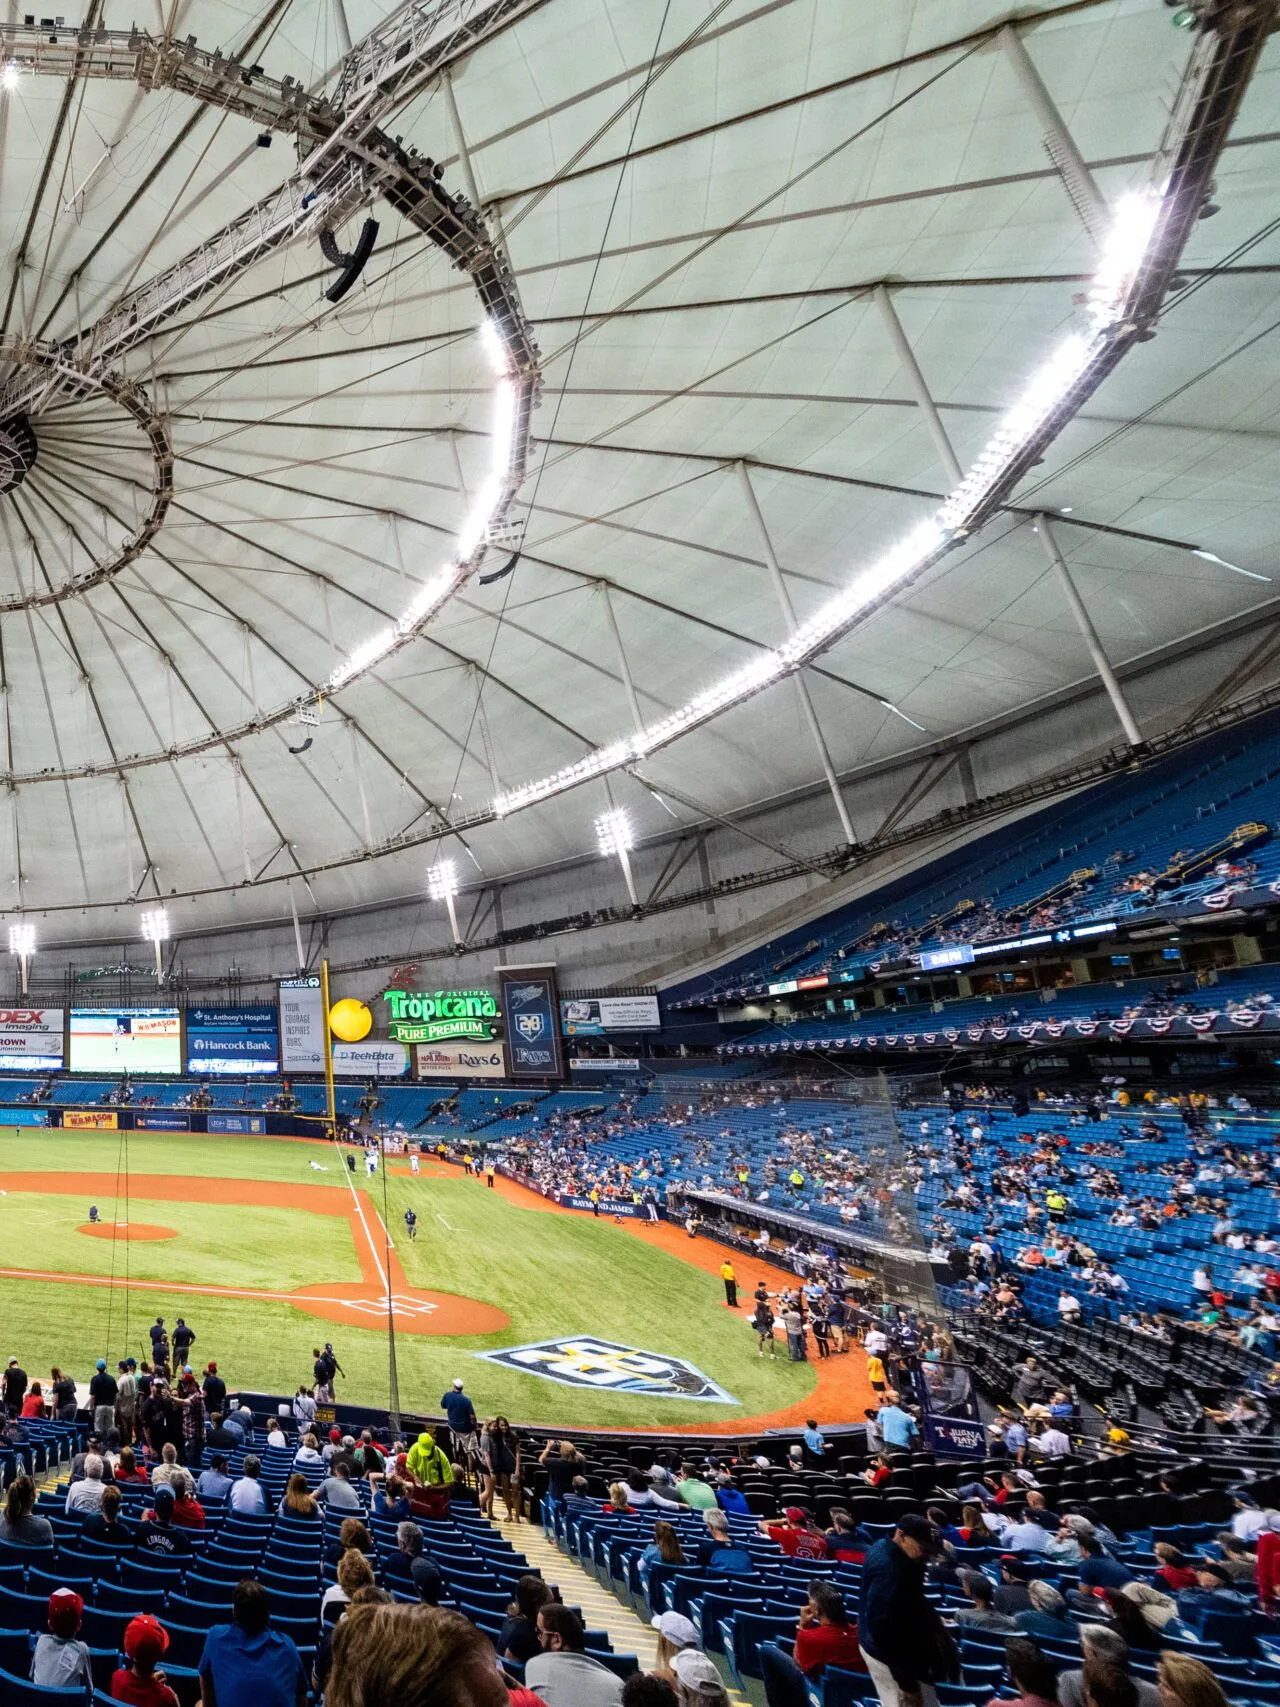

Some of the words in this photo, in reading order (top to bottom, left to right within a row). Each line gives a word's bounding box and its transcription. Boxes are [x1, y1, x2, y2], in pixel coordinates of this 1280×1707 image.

[285, 1003, 300, 1012] YOUR
[384, 990, 497, 1021] Tropicana
[244, 1013, 271, 1021] Hospital
[285, 1014, 310, 1024] COURAGE
[5, 1023, 49, 1031] imaging
[285, 1026, 310, 1035] INSPIRES
[397, 1028, 427, 1040] PURE
[429, 1021, 483, 1039] PREMIUM
[206, 1040, 246, 1050] Hancock
[247, 1040, 270, 1050] Bank
[489, 1053, 501, 1065] 6
[572, 1199, 607, 1211] RAYMND
[608, 1202, 634, 1214] JAMES
[952, 1436, 978, 1447] FLATS
[146, 1535, 175, 1551] LONGORIA
